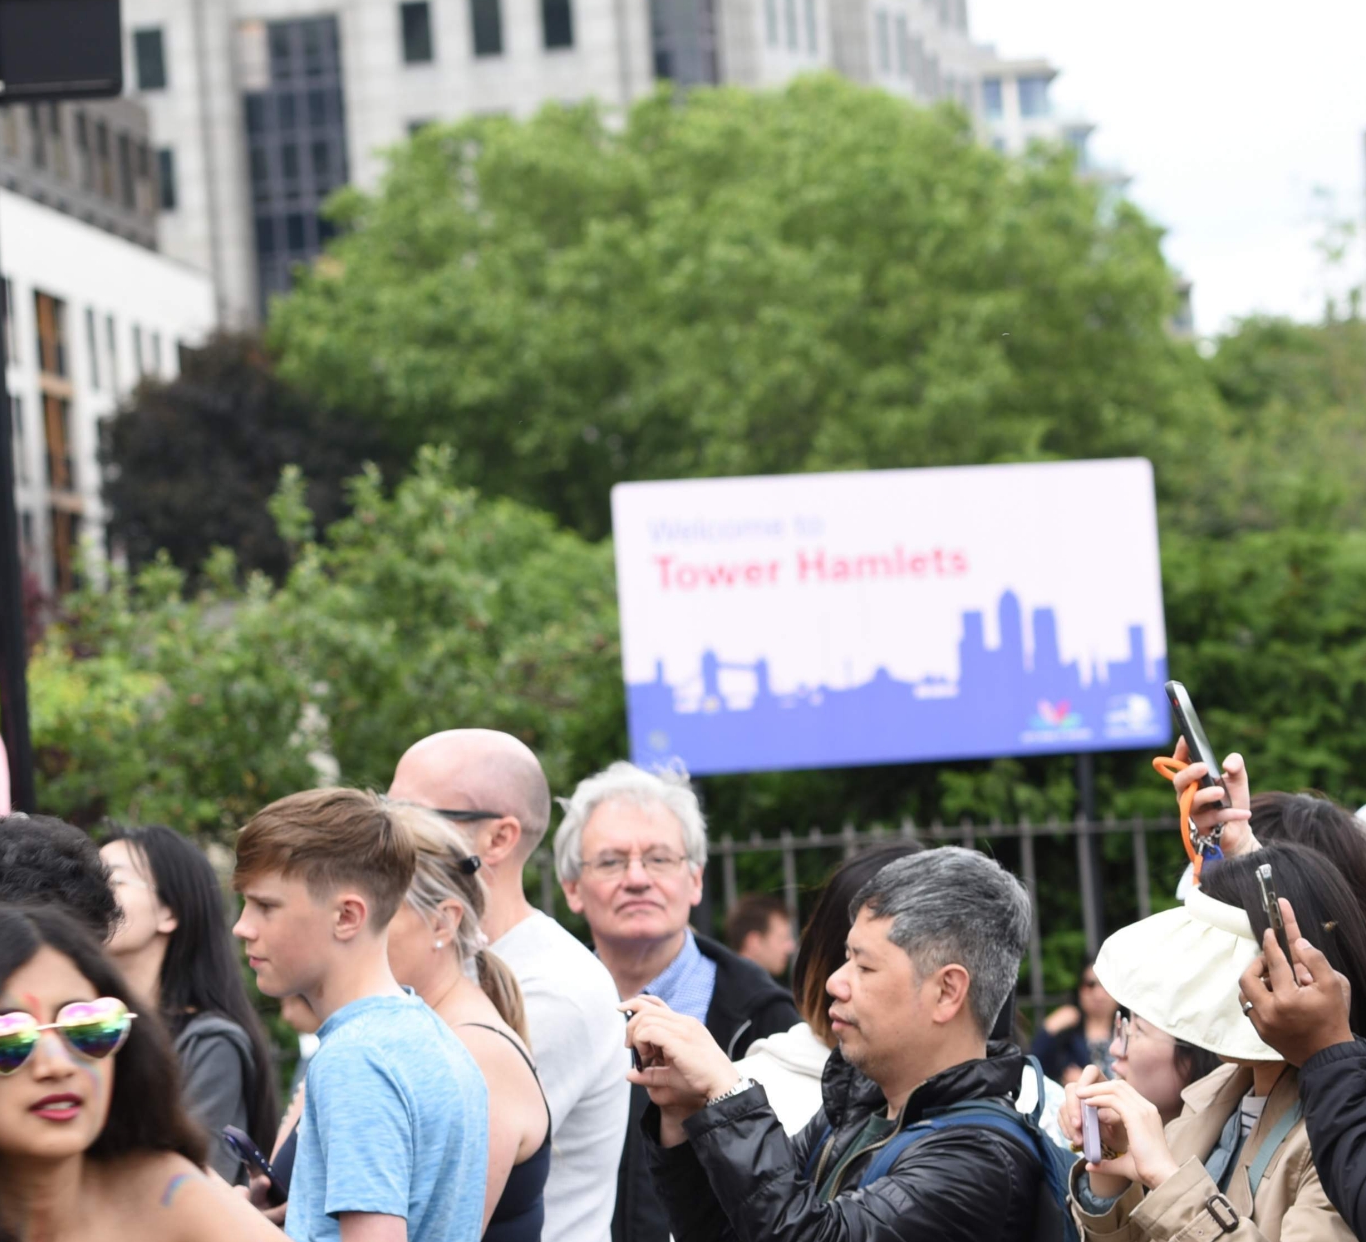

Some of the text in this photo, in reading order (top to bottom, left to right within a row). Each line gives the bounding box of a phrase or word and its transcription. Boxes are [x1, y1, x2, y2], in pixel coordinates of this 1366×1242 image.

[648, 514, 825, 544] Welcome to
[653, 544, 970, 592] Tower Hamlets
